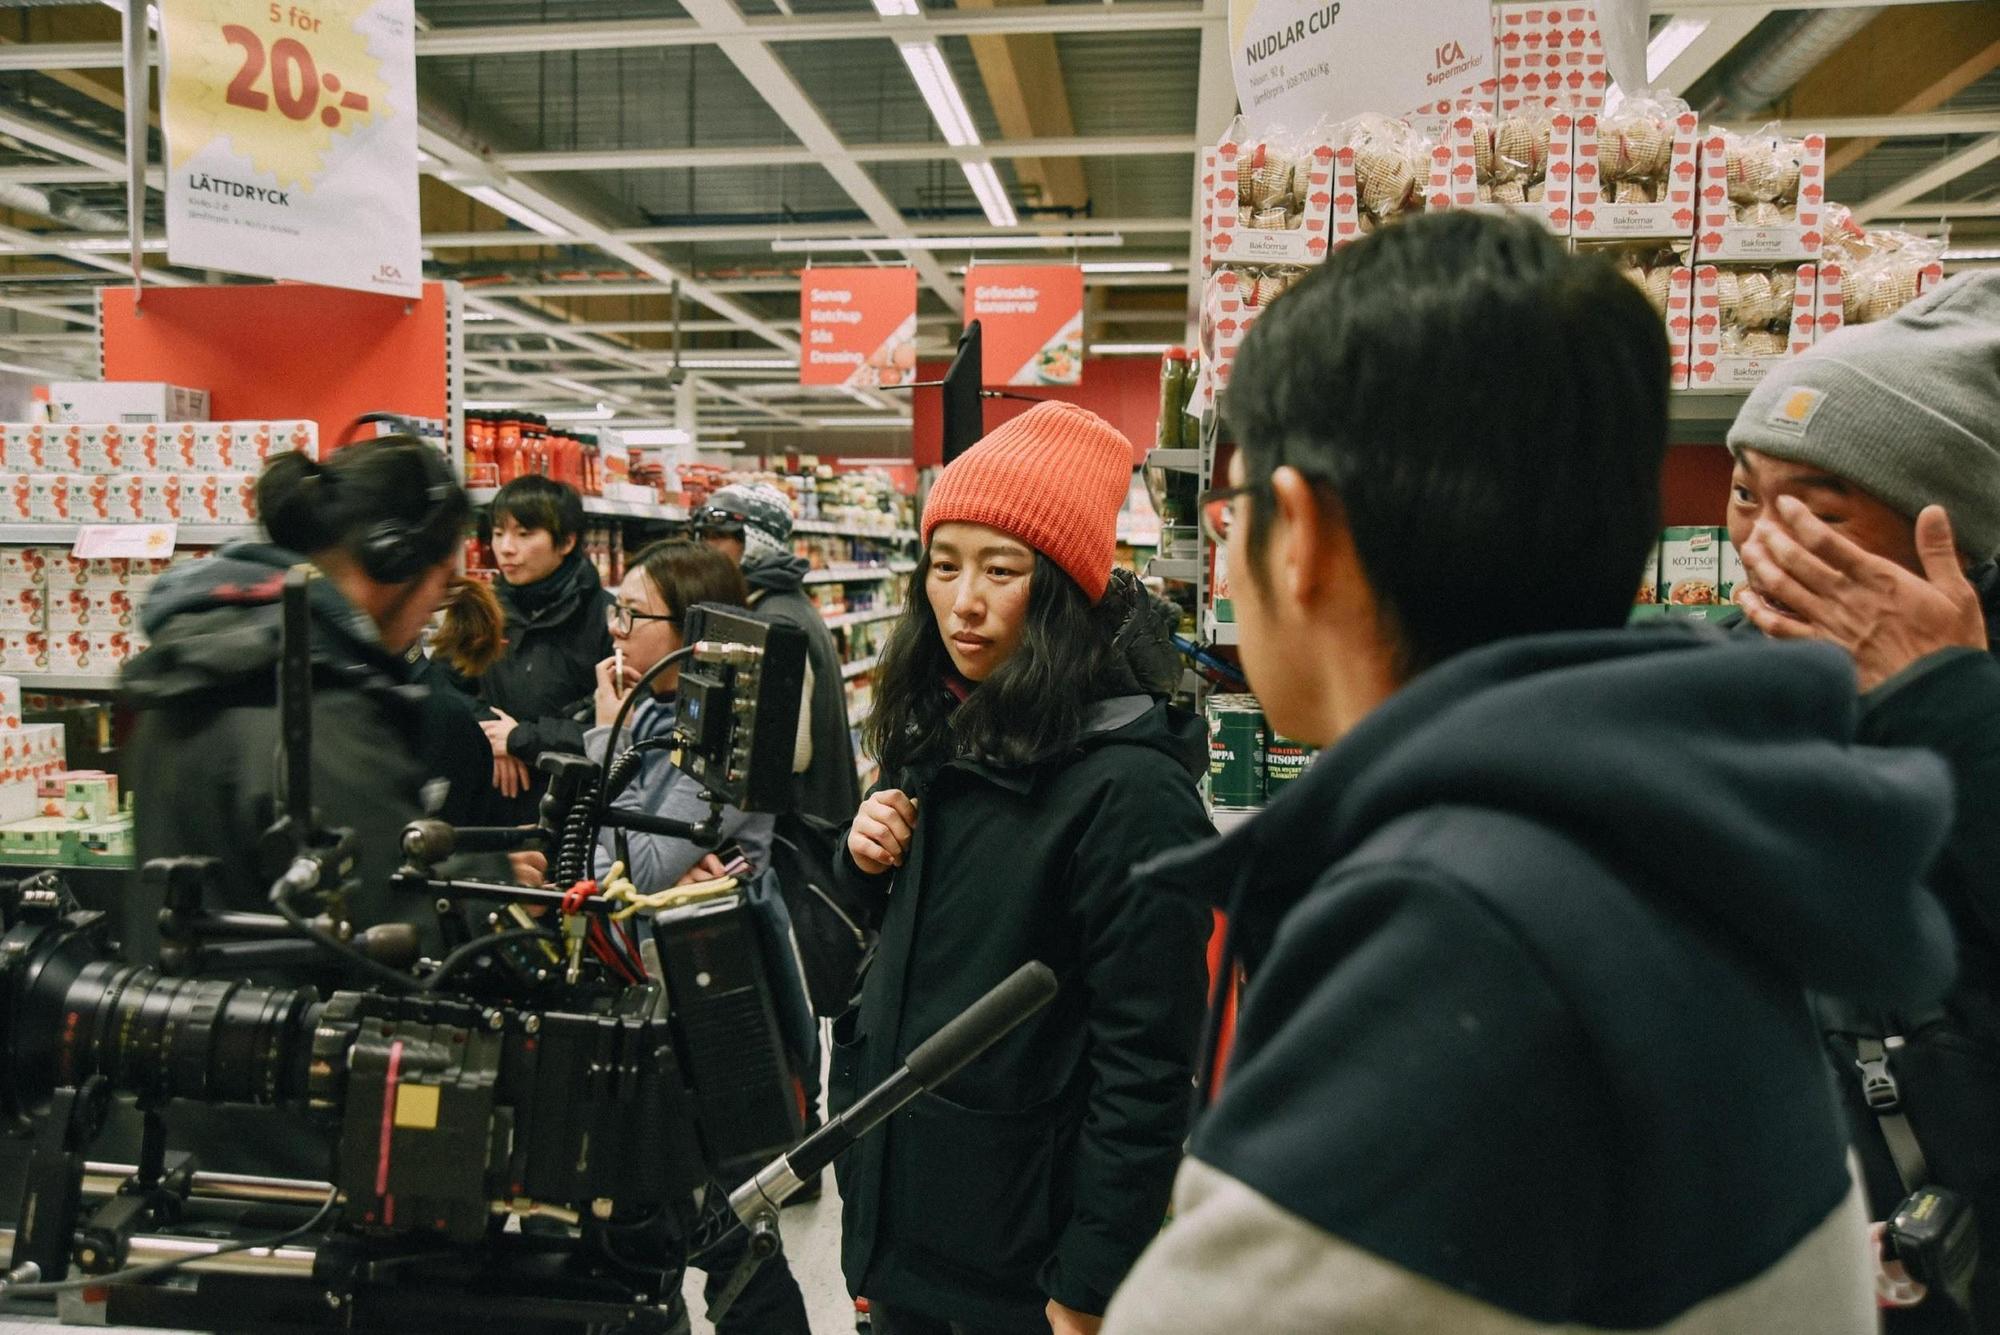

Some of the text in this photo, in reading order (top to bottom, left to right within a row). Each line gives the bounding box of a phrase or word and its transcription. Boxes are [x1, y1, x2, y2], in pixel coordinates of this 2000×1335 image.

[270, 3, 322, 33] 5 för
[1246, 2, 1341, 66] NUDLAR CUP
[1435, 40, 1465, 69] ICA
[221, 24, 369, 128] 20:-
[1426, 55, 1483, 86] Supermarket
[190, 173, 289, 206] LÄTTDRYCK
[1249, 242, 1288, 250] Bakformar
[1733, 368, 1767, 376] Bakform
